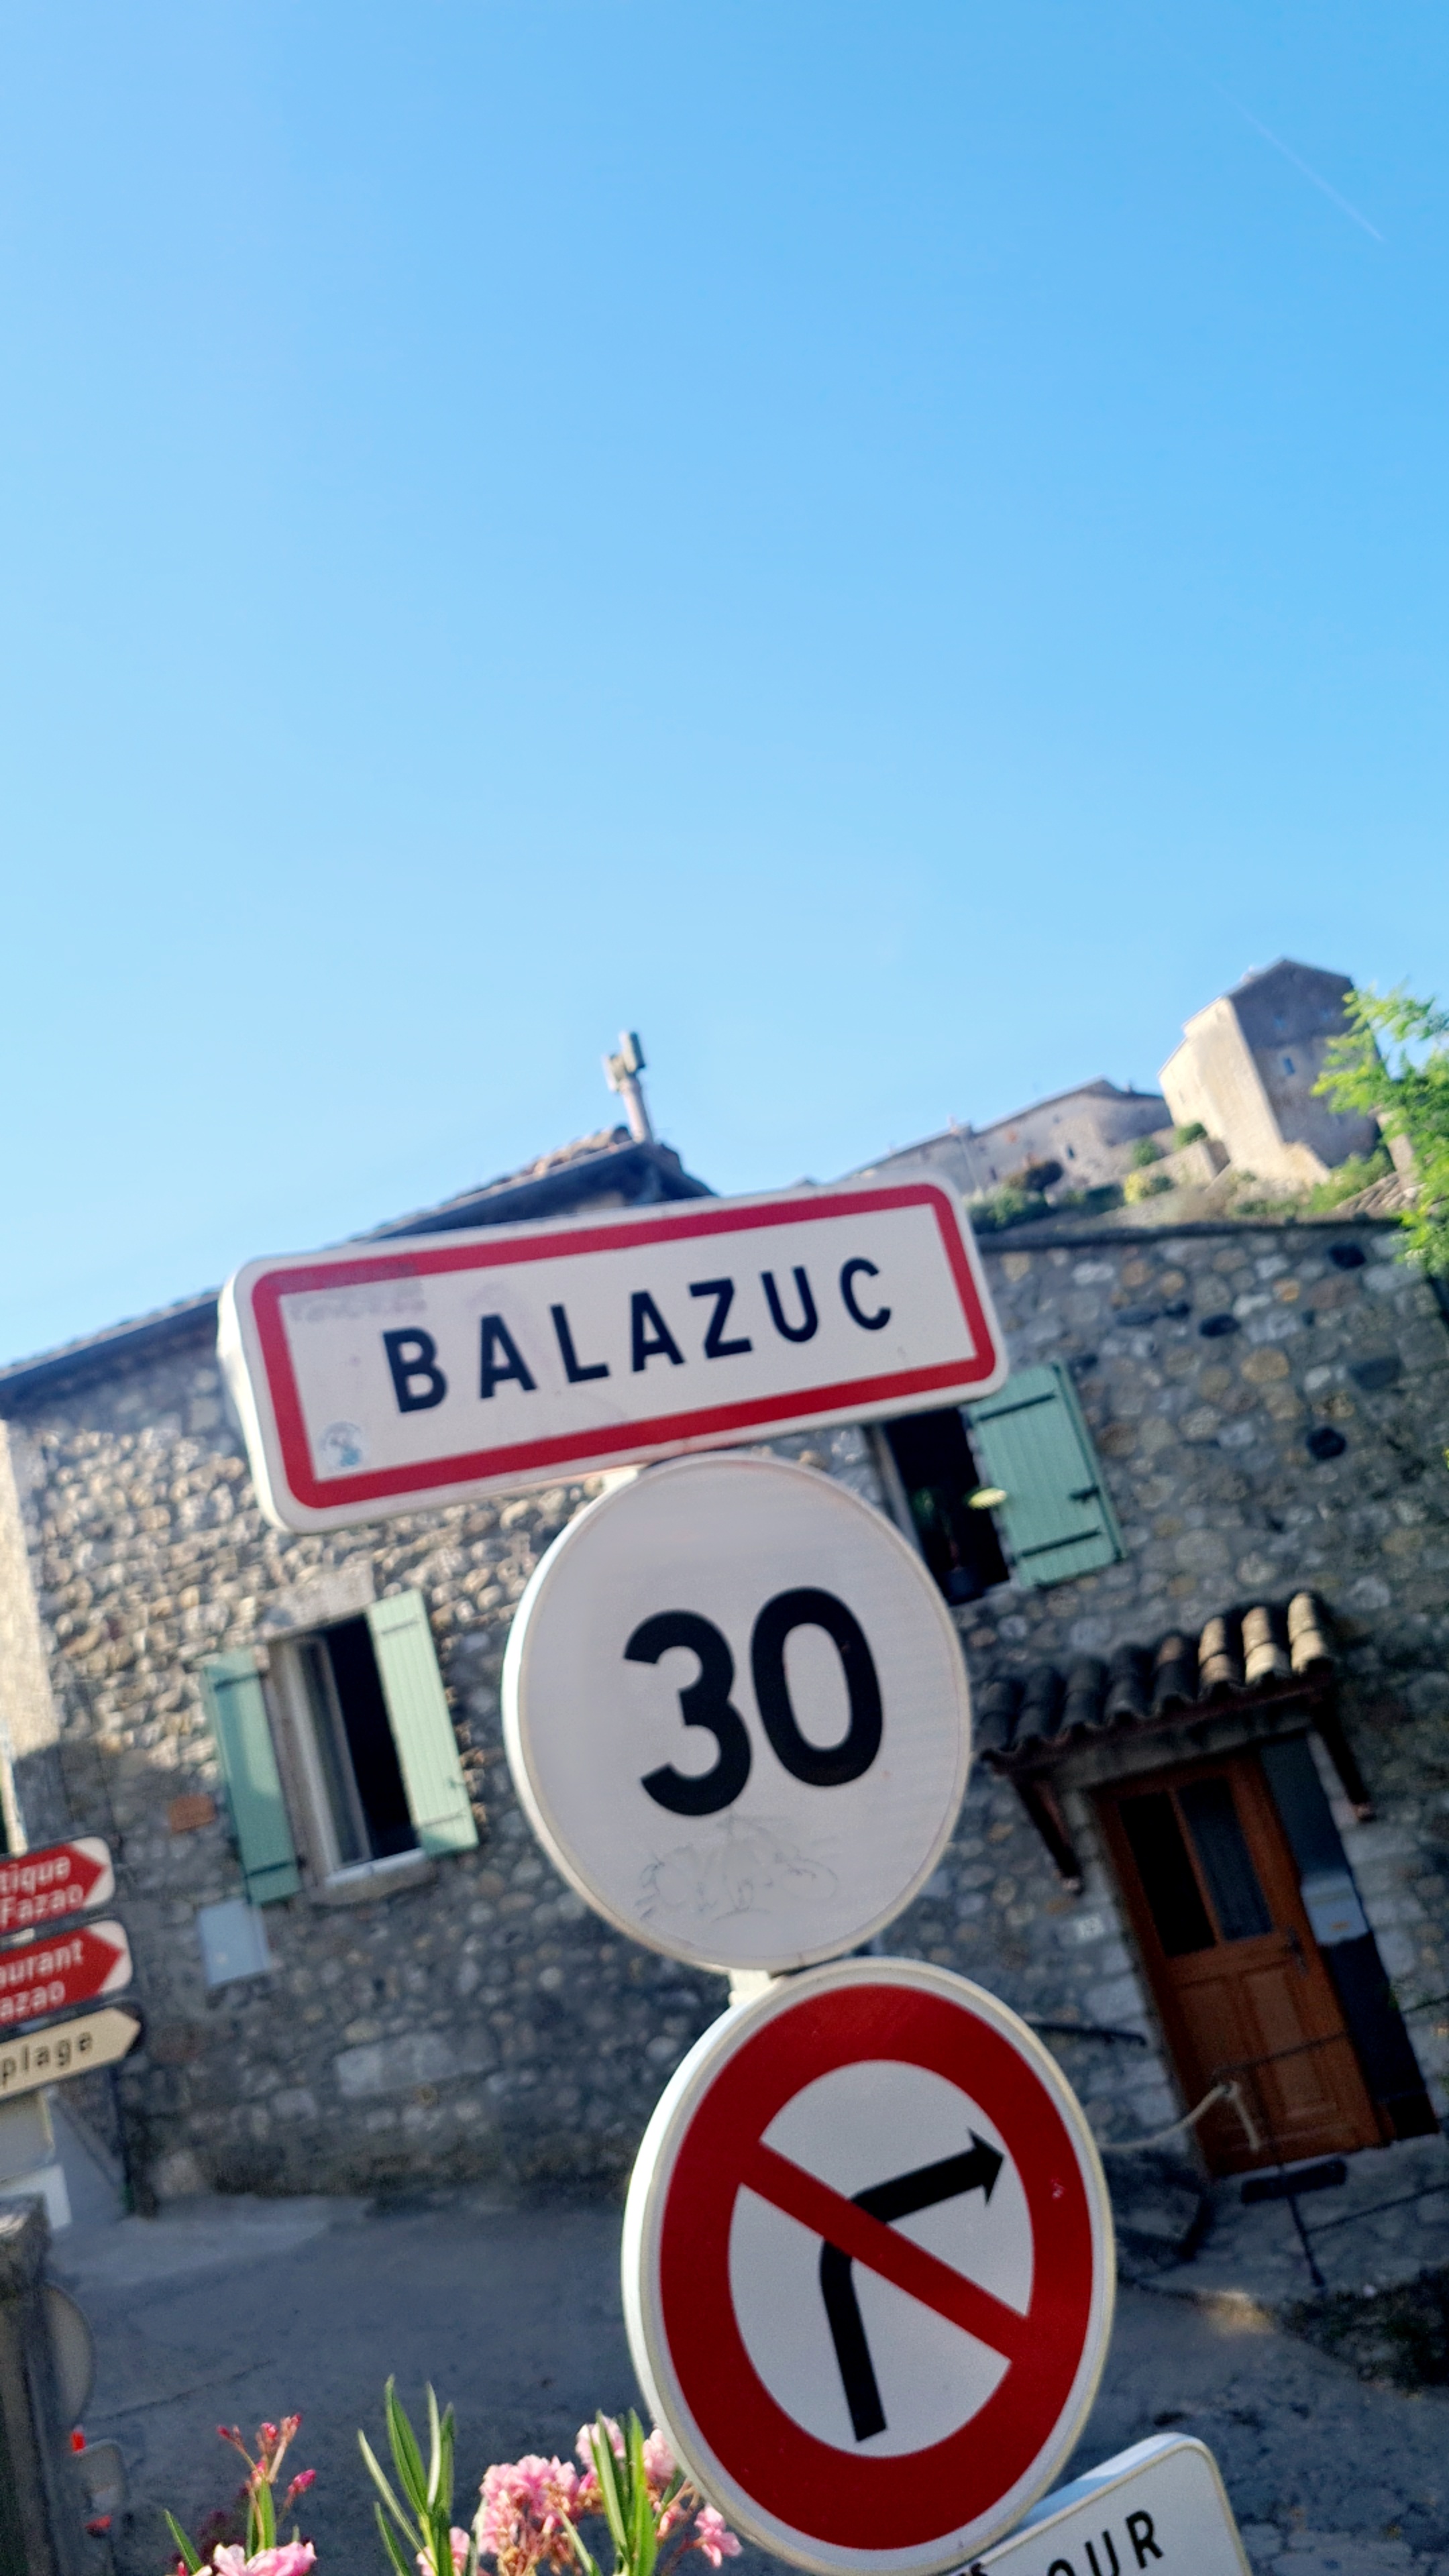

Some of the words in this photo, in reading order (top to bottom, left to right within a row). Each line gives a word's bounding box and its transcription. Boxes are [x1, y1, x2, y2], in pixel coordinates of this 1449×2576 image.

[382, 1258, 892, 1413] BALAZUC
[623, 1586, 883, 1817] 30
[1, 2031, 93, 2088] plage
